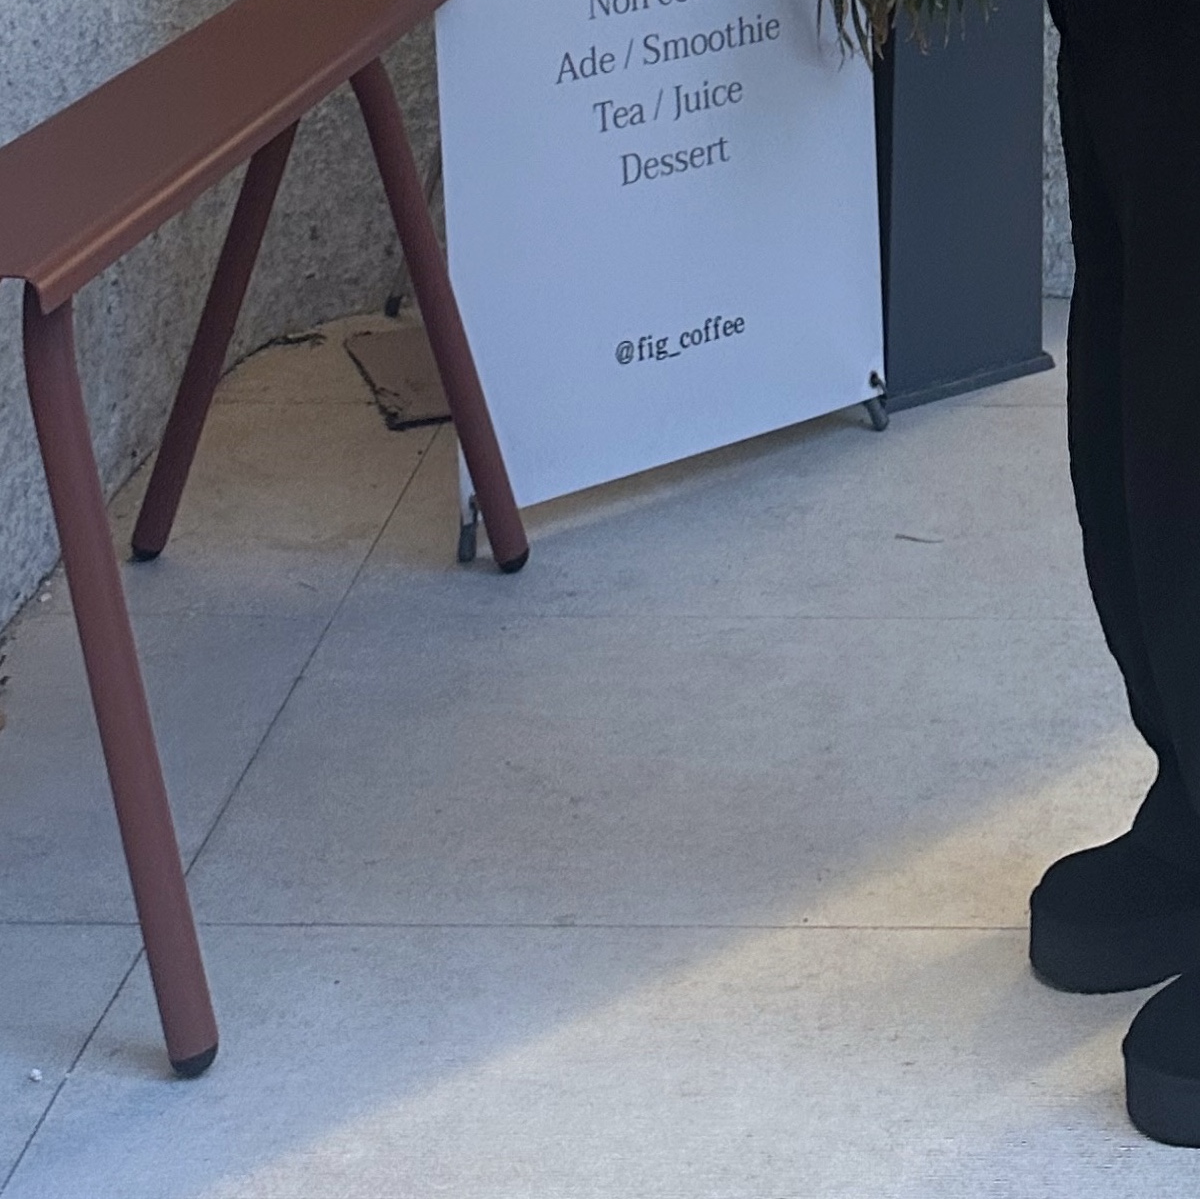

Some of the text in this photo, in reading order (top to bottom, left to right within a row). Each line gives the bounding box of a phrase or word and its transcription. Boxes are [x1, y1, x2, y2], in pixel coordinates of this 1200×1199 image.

[556, 13, 781, 85] Ade / Smoothie
[592, 80, 744, 133] Tea / Juice
[620, 136, 732, 187] Dessert
[614, 315, 746, 365] @fig_coffee
